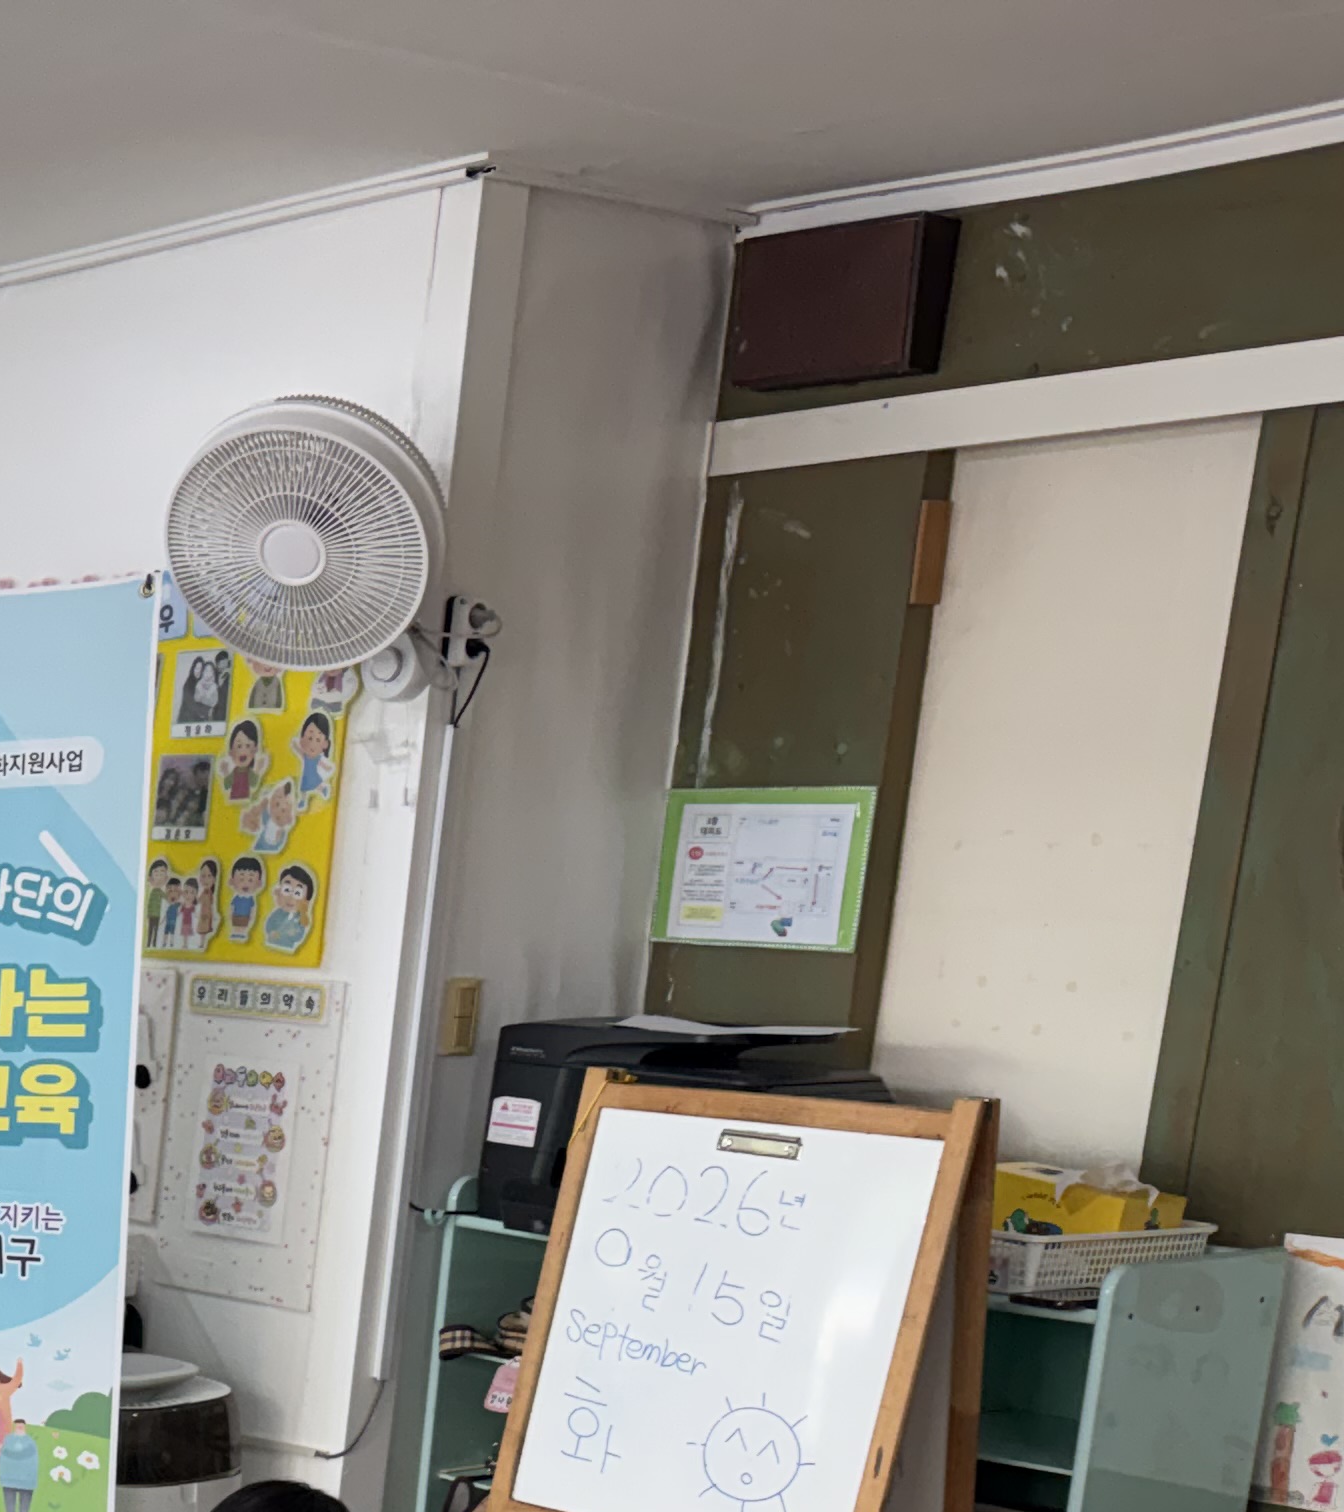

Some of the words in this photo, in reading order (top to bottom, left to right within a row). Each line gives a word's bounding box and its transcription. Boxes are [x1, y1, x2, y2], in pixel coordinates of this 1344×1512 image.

[601, 1157, 806, 1237] 2026년
[566, 1307, 707, 1376] September
[561, 1375, 621, 1474] 화
